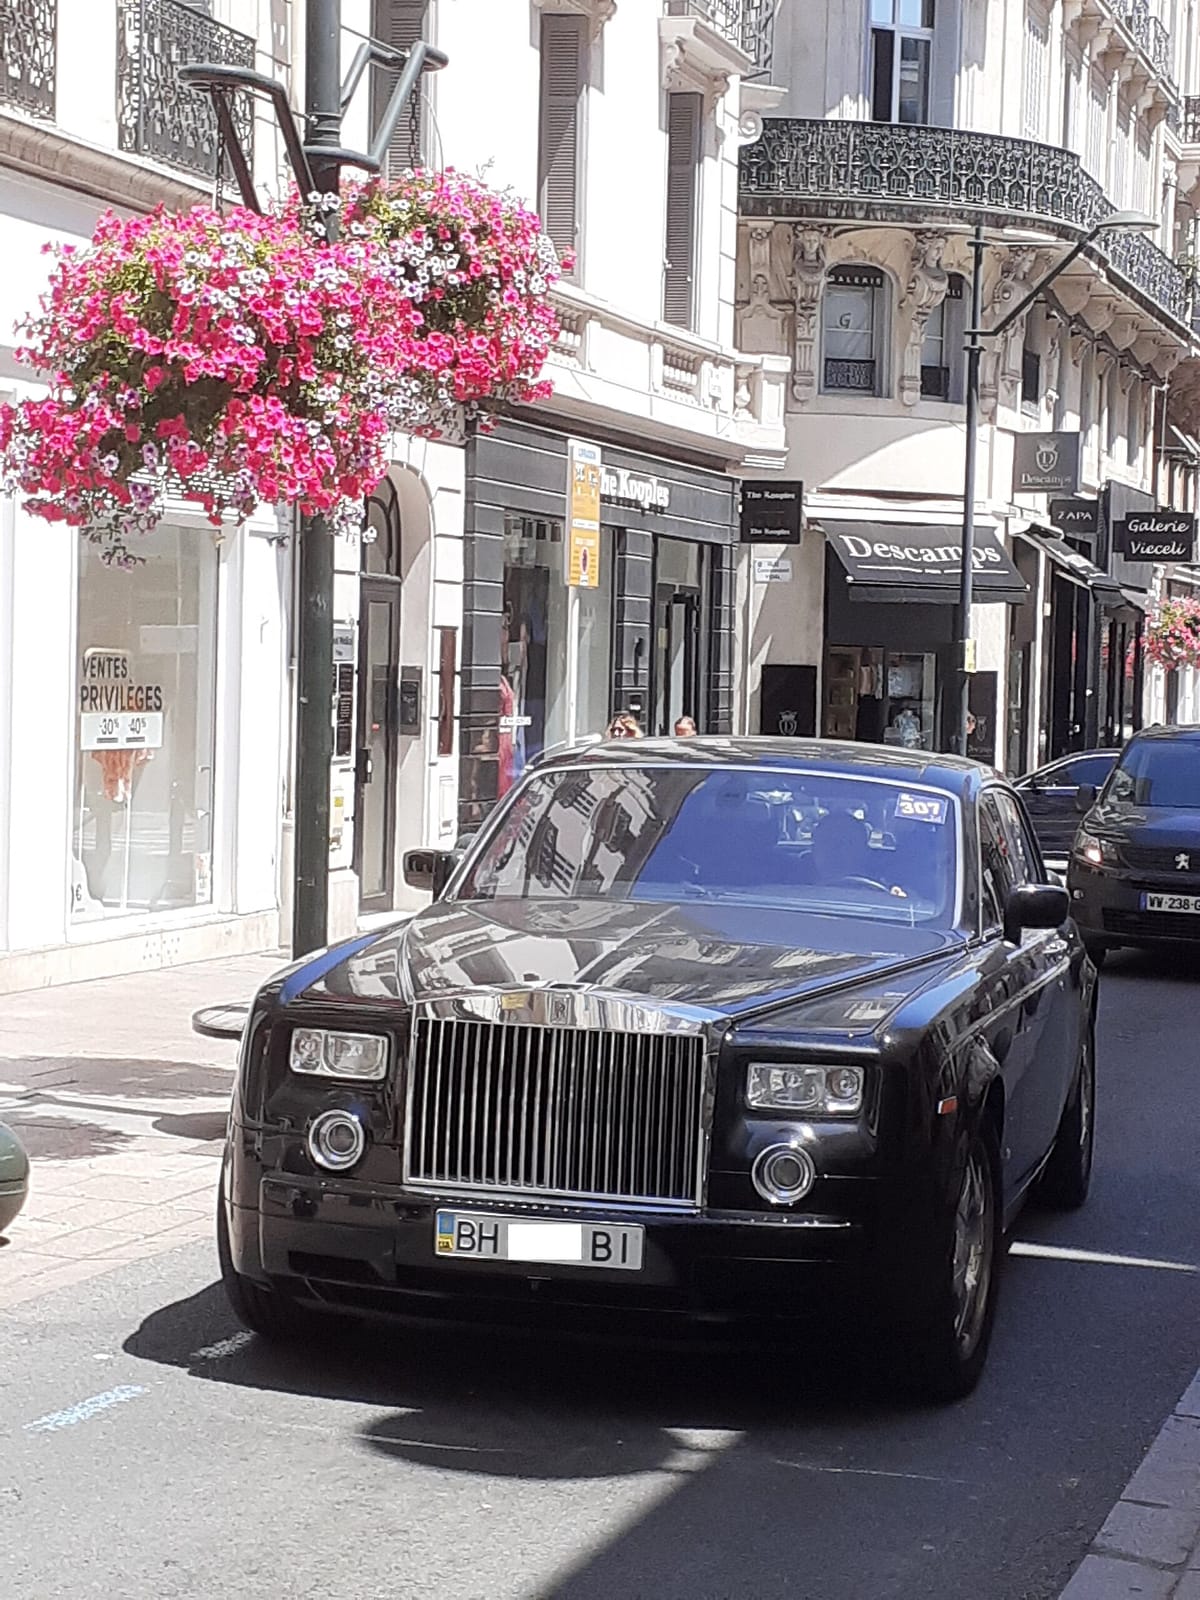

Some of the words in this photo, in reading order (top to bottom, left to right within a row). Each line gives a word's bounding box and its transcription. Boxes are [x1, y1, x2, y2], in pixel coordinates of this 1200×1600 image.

[616, 469, 670, 509] Kooples
[1022, 473, 1073, 488] Descamps
[1058, 511, 1093, 521] ZAPA
[1128, 518, 1190, 532] Galerie
[839, 534, 1001, 569] Descamps
[1131, 541, 1187, 555] Vieceli
[82, 657, 128, 679] VENTES
[80, 679, 163, 711] PRIVILÈGES
[900, 801, 940, 816] 307
[456, 1220, 499, 1254] BH
